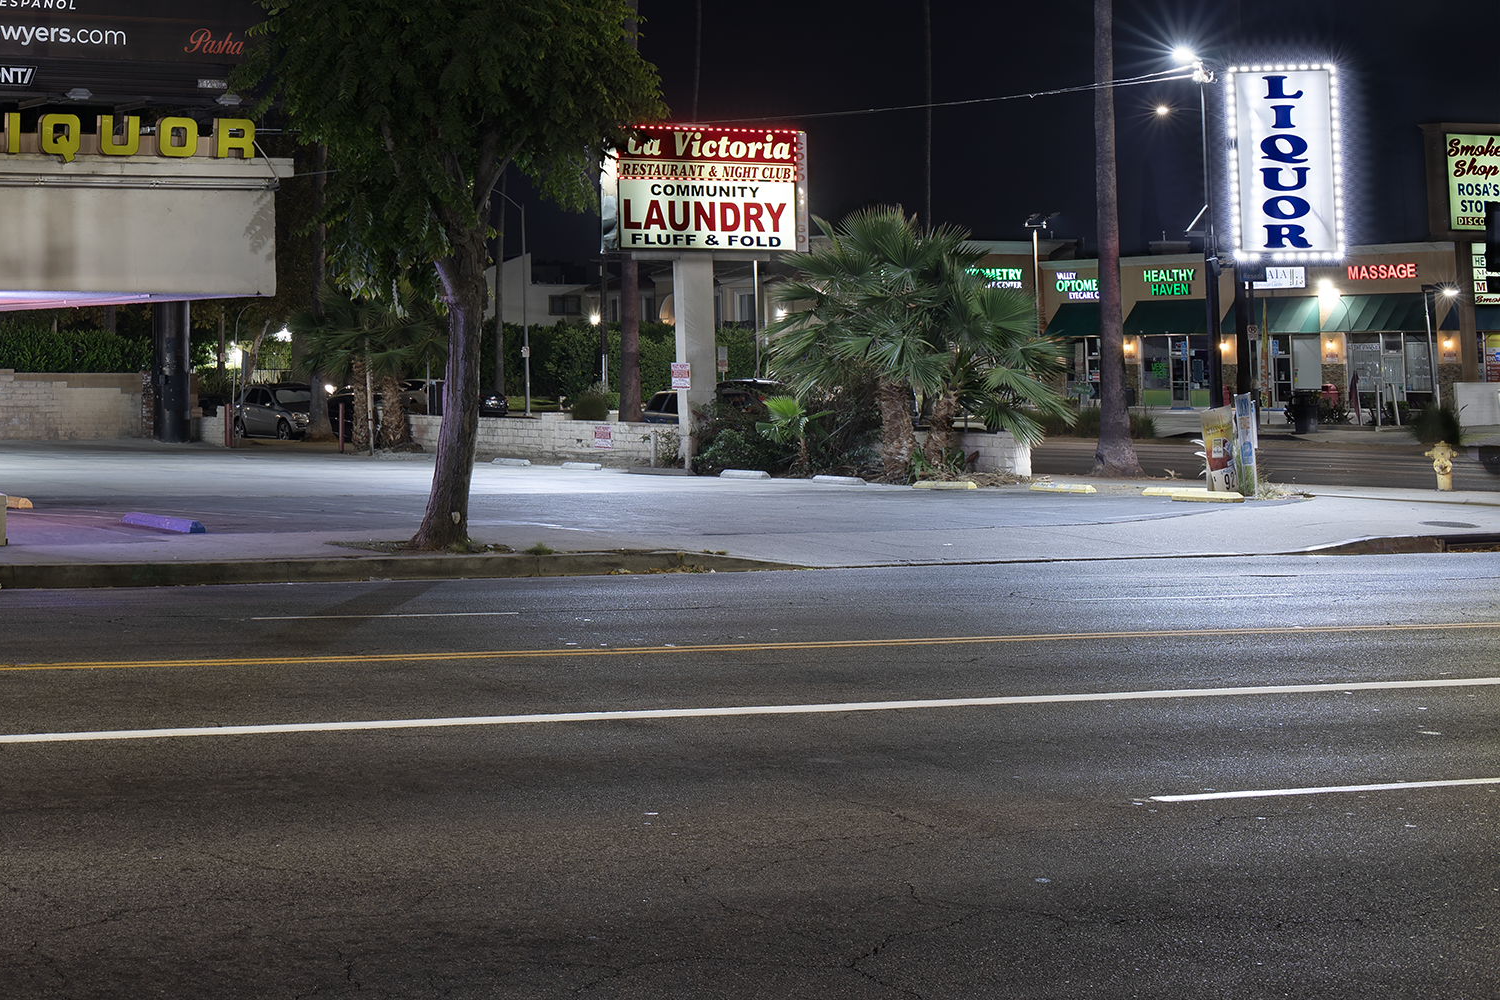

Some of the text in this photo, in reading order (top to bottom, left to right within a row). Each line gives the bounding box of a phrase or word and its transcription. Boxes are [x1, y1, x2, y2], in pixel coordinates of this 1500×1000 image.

[184, 28, 244, 55] Pasha
[673, 131, 792, 160] Victoria
[1259, 75, 1313, 249] LIQUOR
[1453, 157, 1499, 180] Shop
[622, 163, 792, 180] RESTAURANT & NIGHT CLUB
[650, 183, 760, 198] COMMUNITY
[1457, 182, 1500, 196] ROSA'S
[1460, 200, 1486, 213] STO
[623, 198, 787, 233] LAUNDRY
[1458, 217, 1485, 226] DISCO
[631, 233, 782, 247] FLUFF & FOLD
[1056, 271, 1077, 280] VALLEY
[1143, 268, 1195, 283] HEALTHY
[1347, 263, 1417, 280] MASSAGE
[1056, 279, 1099, 292] OPTOME
[1151, 283, 1189, 296] HAVEN
